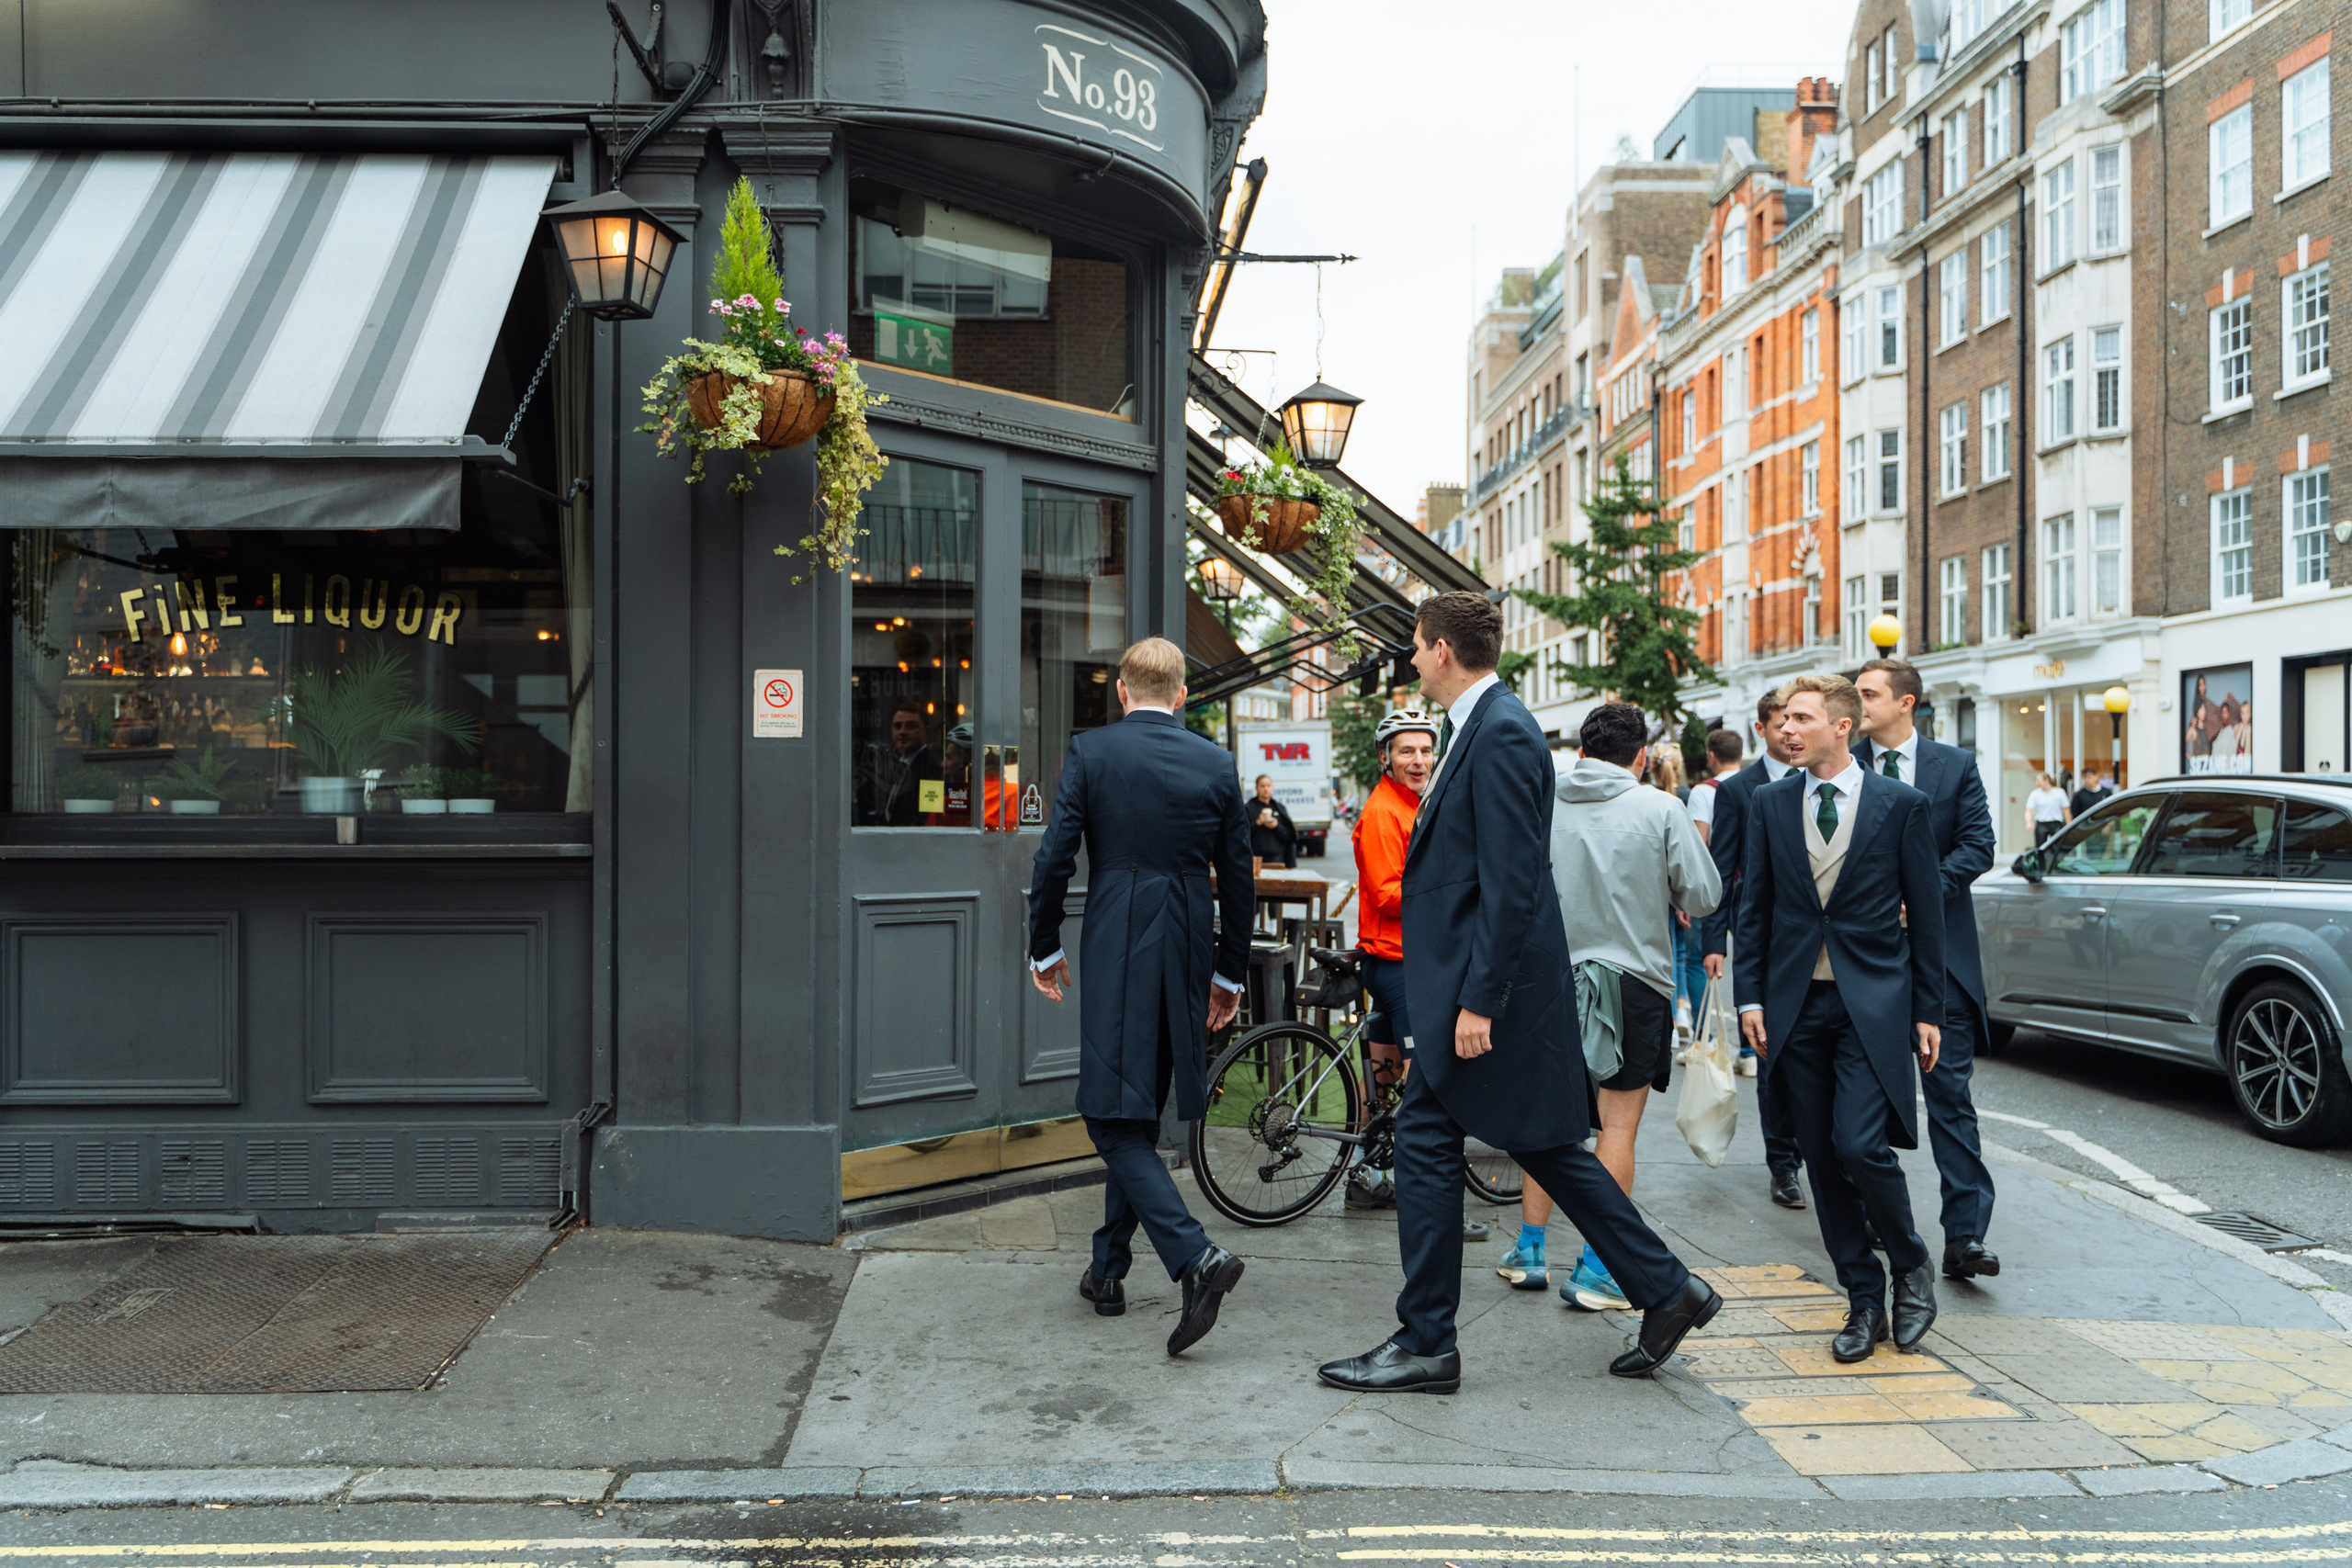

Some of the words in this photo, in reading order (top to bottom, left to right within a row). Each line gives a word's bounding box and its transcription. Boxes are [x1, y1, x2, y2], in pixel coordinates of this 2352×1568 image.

[119, 575, 243, 643] FINE
[272, 573, 463, 646] LIQUOR
[2033, 660, 2065, 679] maje
[1260, 742, 1310, 761] TVR
